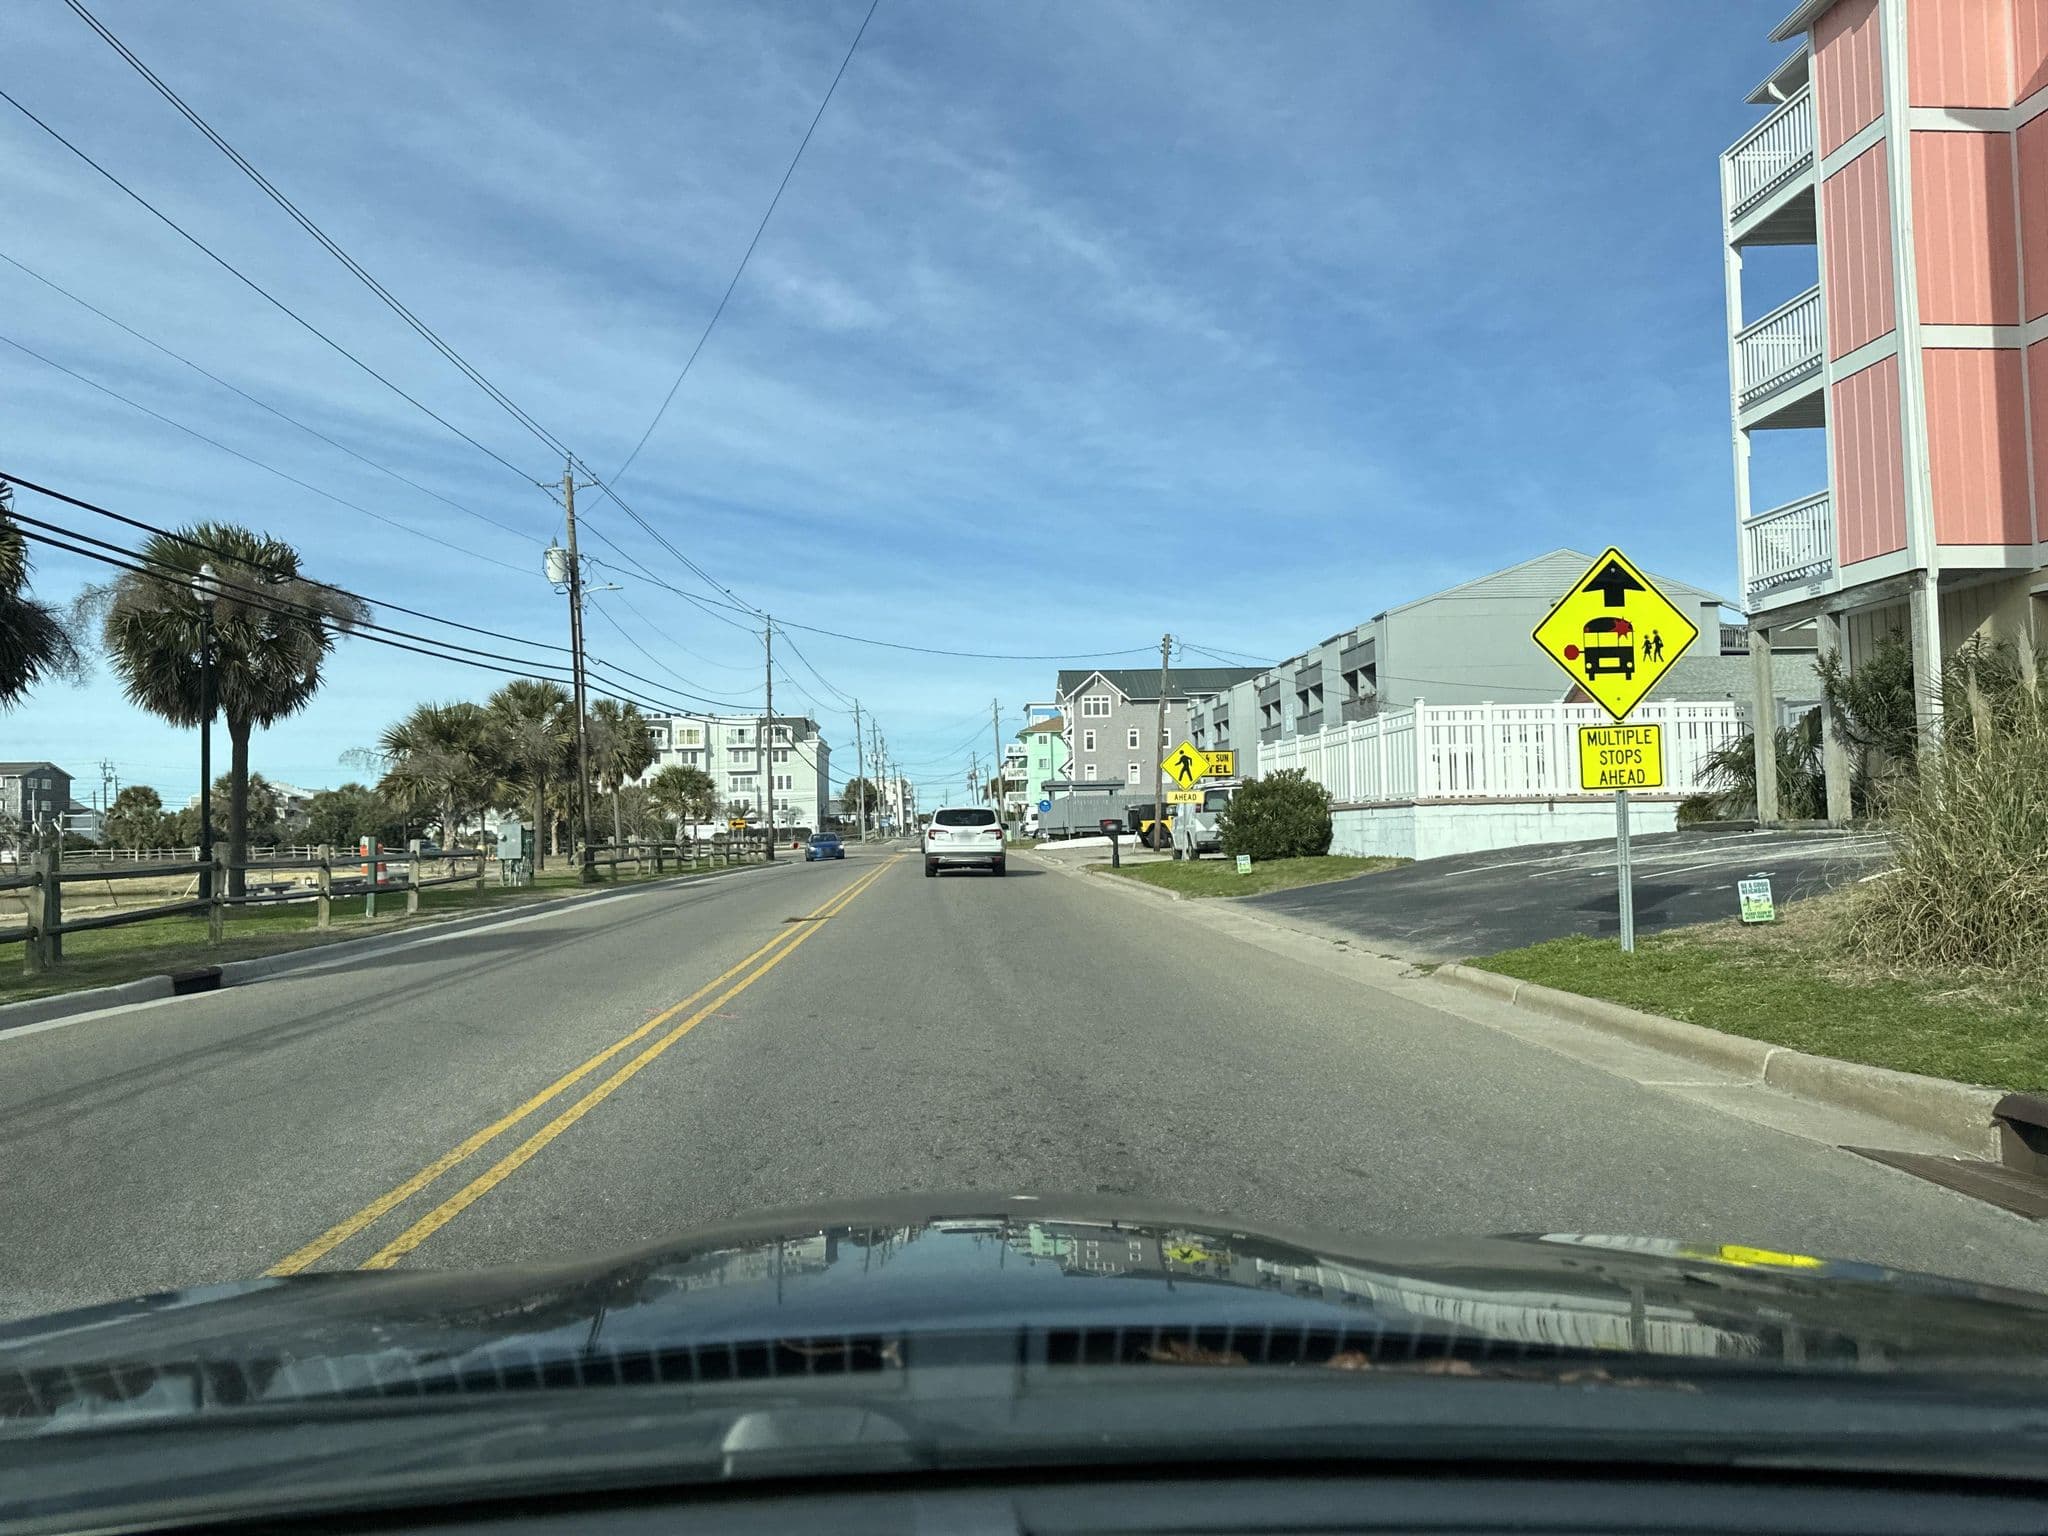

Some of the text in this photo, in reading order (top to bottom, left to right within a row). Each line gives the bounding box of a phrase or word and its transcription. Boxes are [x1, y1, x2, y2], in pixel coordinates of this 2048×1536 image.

[1587, 729, 1652, 746] MULTIPLE
[1216, 754, 1229, 762] SUN
[1600, 749, 1642, 765] STOPS
[1208, 765, 1231, 774] TEL
[1600, 769, 1645, 785] AHEAD
[1174, 793, 1197, 801] AHEAD
